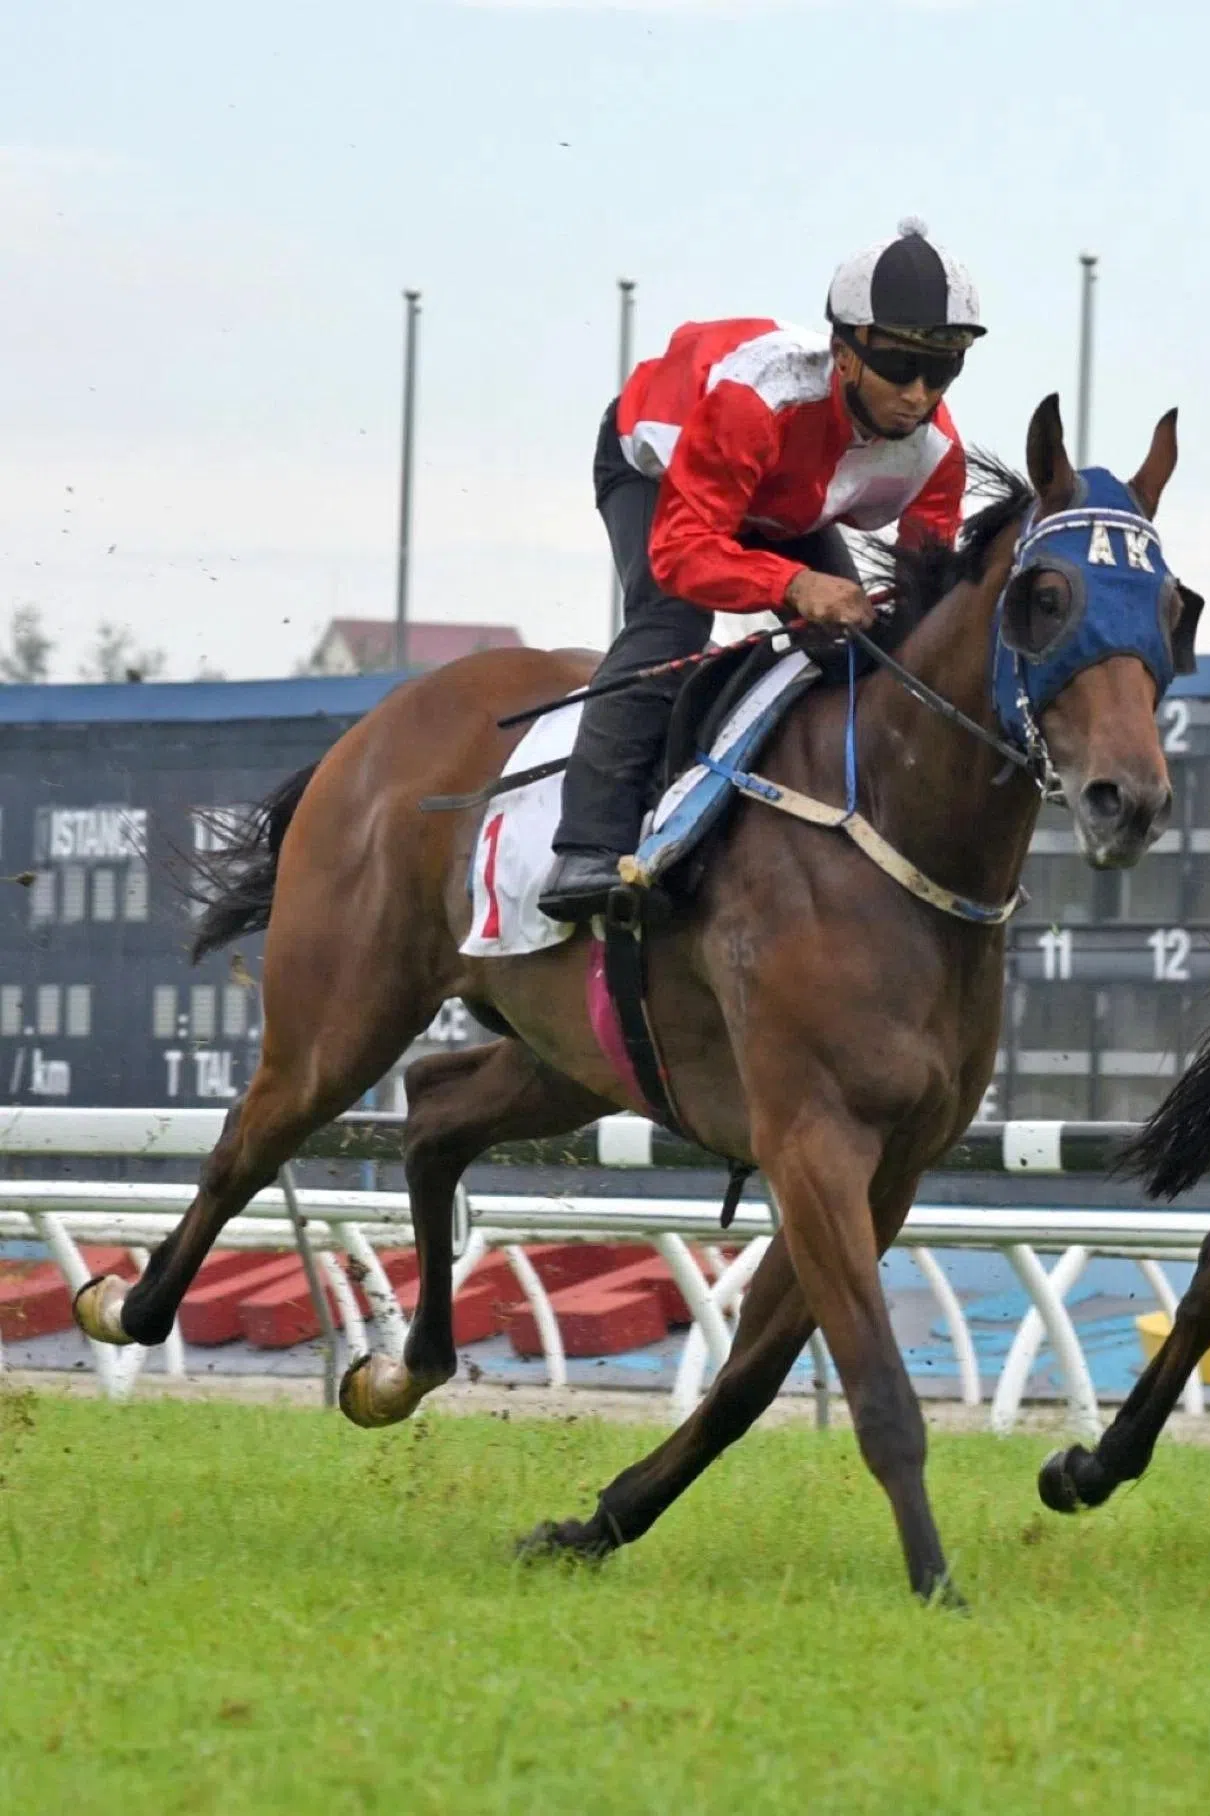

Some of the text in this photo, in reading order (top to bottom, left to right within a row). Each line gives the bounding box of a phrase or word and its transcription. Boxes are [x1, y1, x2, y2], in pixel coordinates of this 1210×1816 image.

[1164, 699, 1189, 753] 2
[482, 813, 504, 938] 1
[1038, 929, 1072, 980] 11
[1147, 929, 1190, 980] 12
